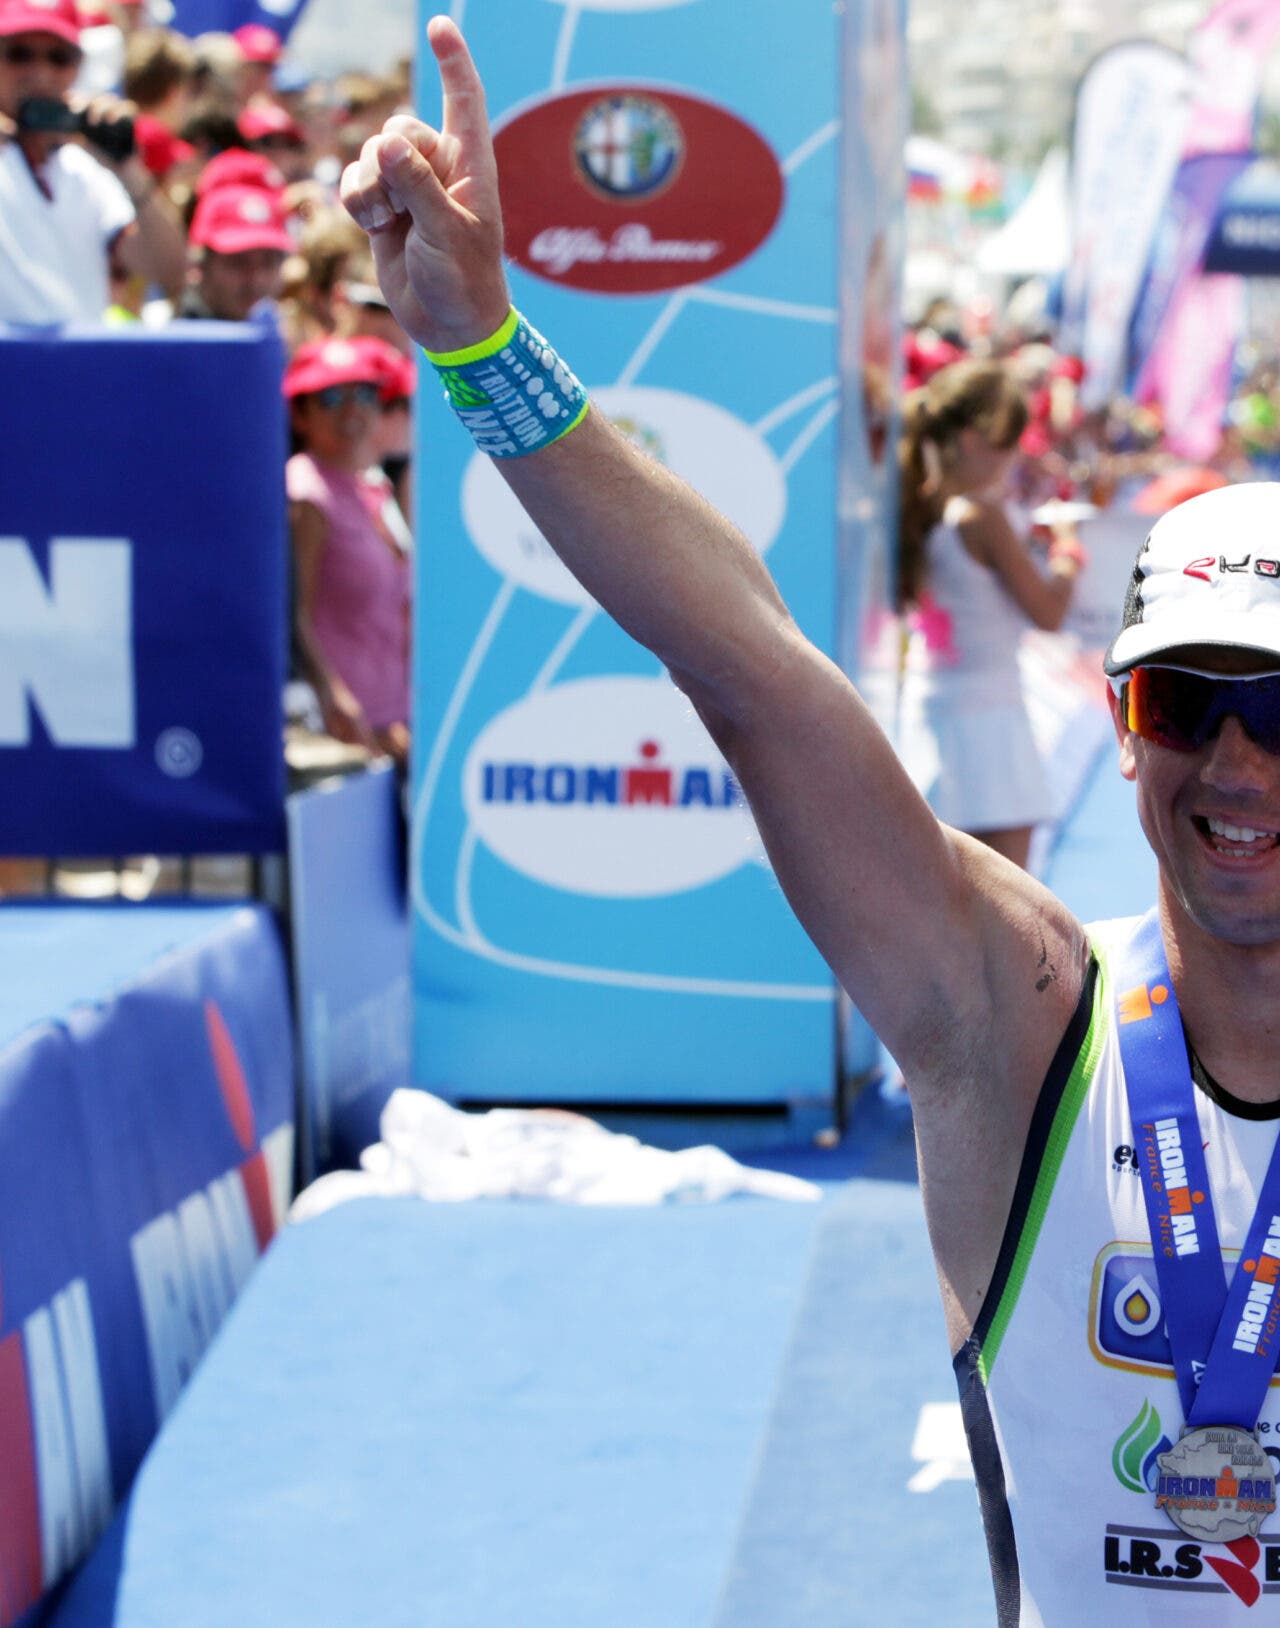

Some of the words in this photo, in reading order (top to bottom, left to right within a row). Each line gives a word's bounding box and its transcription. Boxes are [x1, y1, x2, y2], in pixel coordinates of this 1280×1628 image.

[1142, 1124, 1162, 1193] France
[1157, 1214, 1174, 1258] Nice
[1154, 1117, 1205, 1257] IRONMAN
[1155, 1496, 1219, 1511] France
[1236, 1500, 1276, 1512] Nice
[1157, 1466, 1272, 1499] IRONMAN
